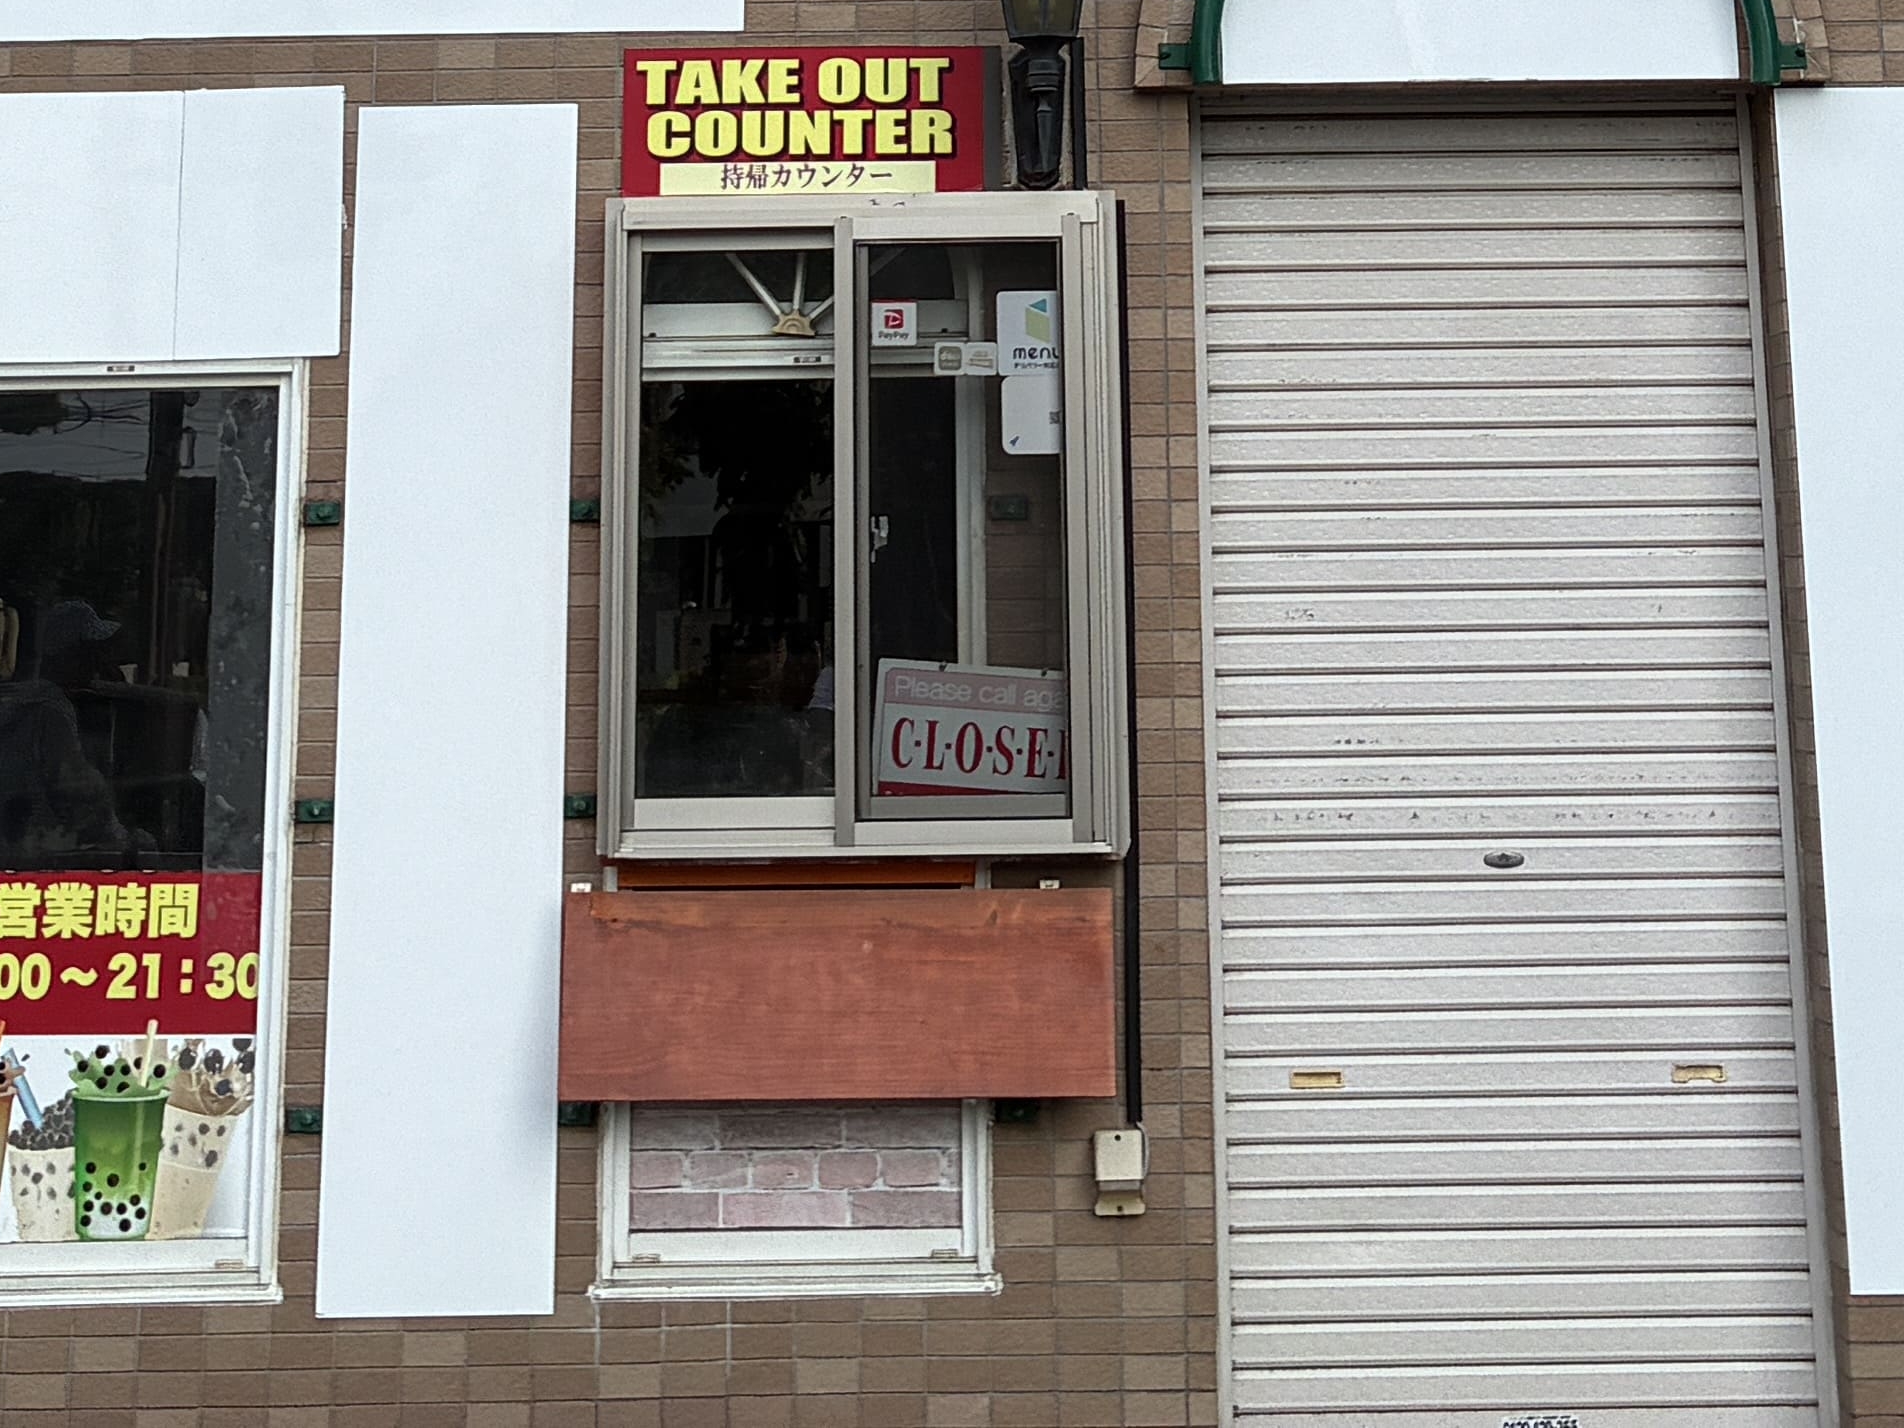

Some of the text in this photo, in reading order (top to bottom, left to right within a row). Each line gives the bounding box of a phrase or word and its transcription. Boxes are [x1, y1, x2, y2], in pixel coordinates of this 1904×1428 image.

[636, 57, 951, 106] TAKE OUT
[647, 109, 955, 158] COUNTER
[720, 163, 894, 191] 持帰カウンター
[894, 675, 971, 703] Please
[978, 683, 1017, 706] call
